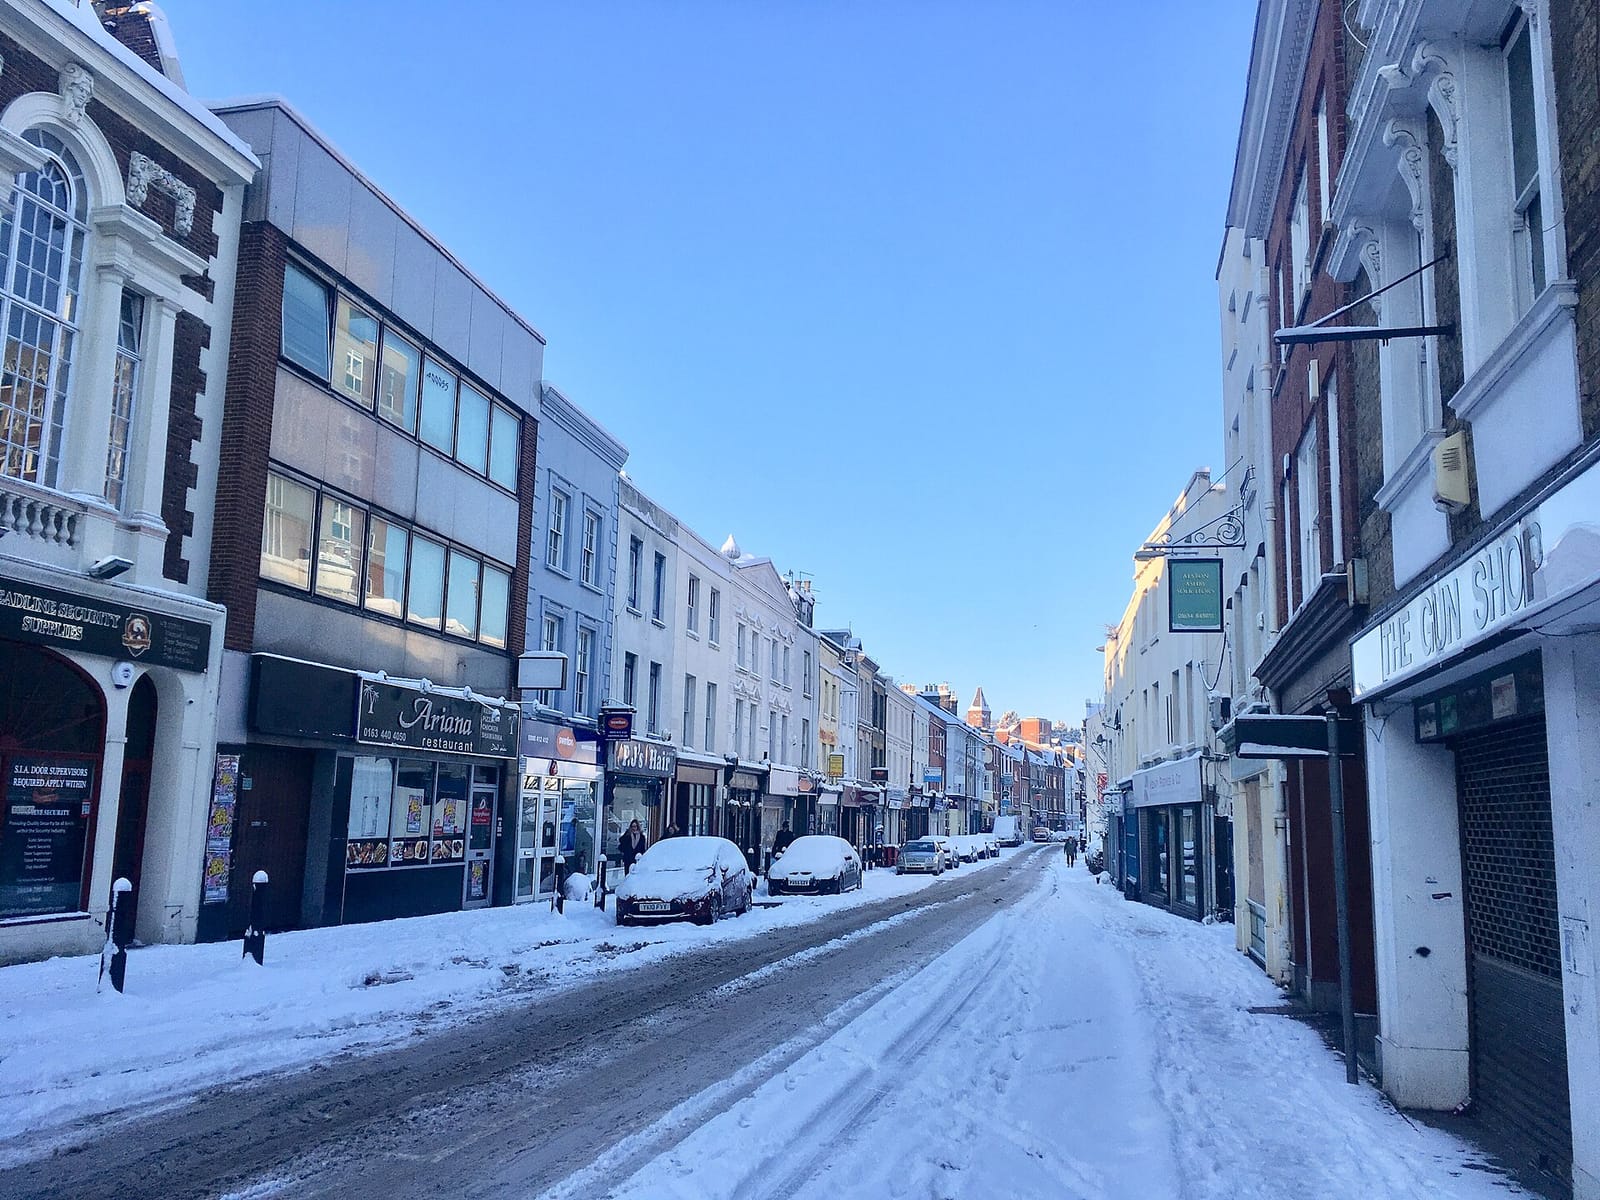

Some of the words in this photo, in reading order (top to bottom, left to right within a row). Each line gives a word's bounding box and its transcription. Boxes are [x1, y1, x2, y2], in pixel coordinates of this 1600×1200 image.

[1382, 610, 1413, 677] THE
[1421, 578, 1462, 658] GUN
[1473, 520, 1544, 631] SHOP
[57, 602, 121, 629] SECURITY
[21, 615, 84, 641] SUPPLIES
[399, 698, 473, 736] Ariana
[363, 727, 379, 738] 0163
[421, 737, 474, 752] restaurant
[30, 765, 48, 775] DOOR
[49, 767, 88, 777] SUPERVISORS
[649, 748, 671, 771] Hair
[12, 777, 45, 788] REQUIRED
[45, 779, 65, 788] APPLY
[65, 780, 87, 789] WITHIN
